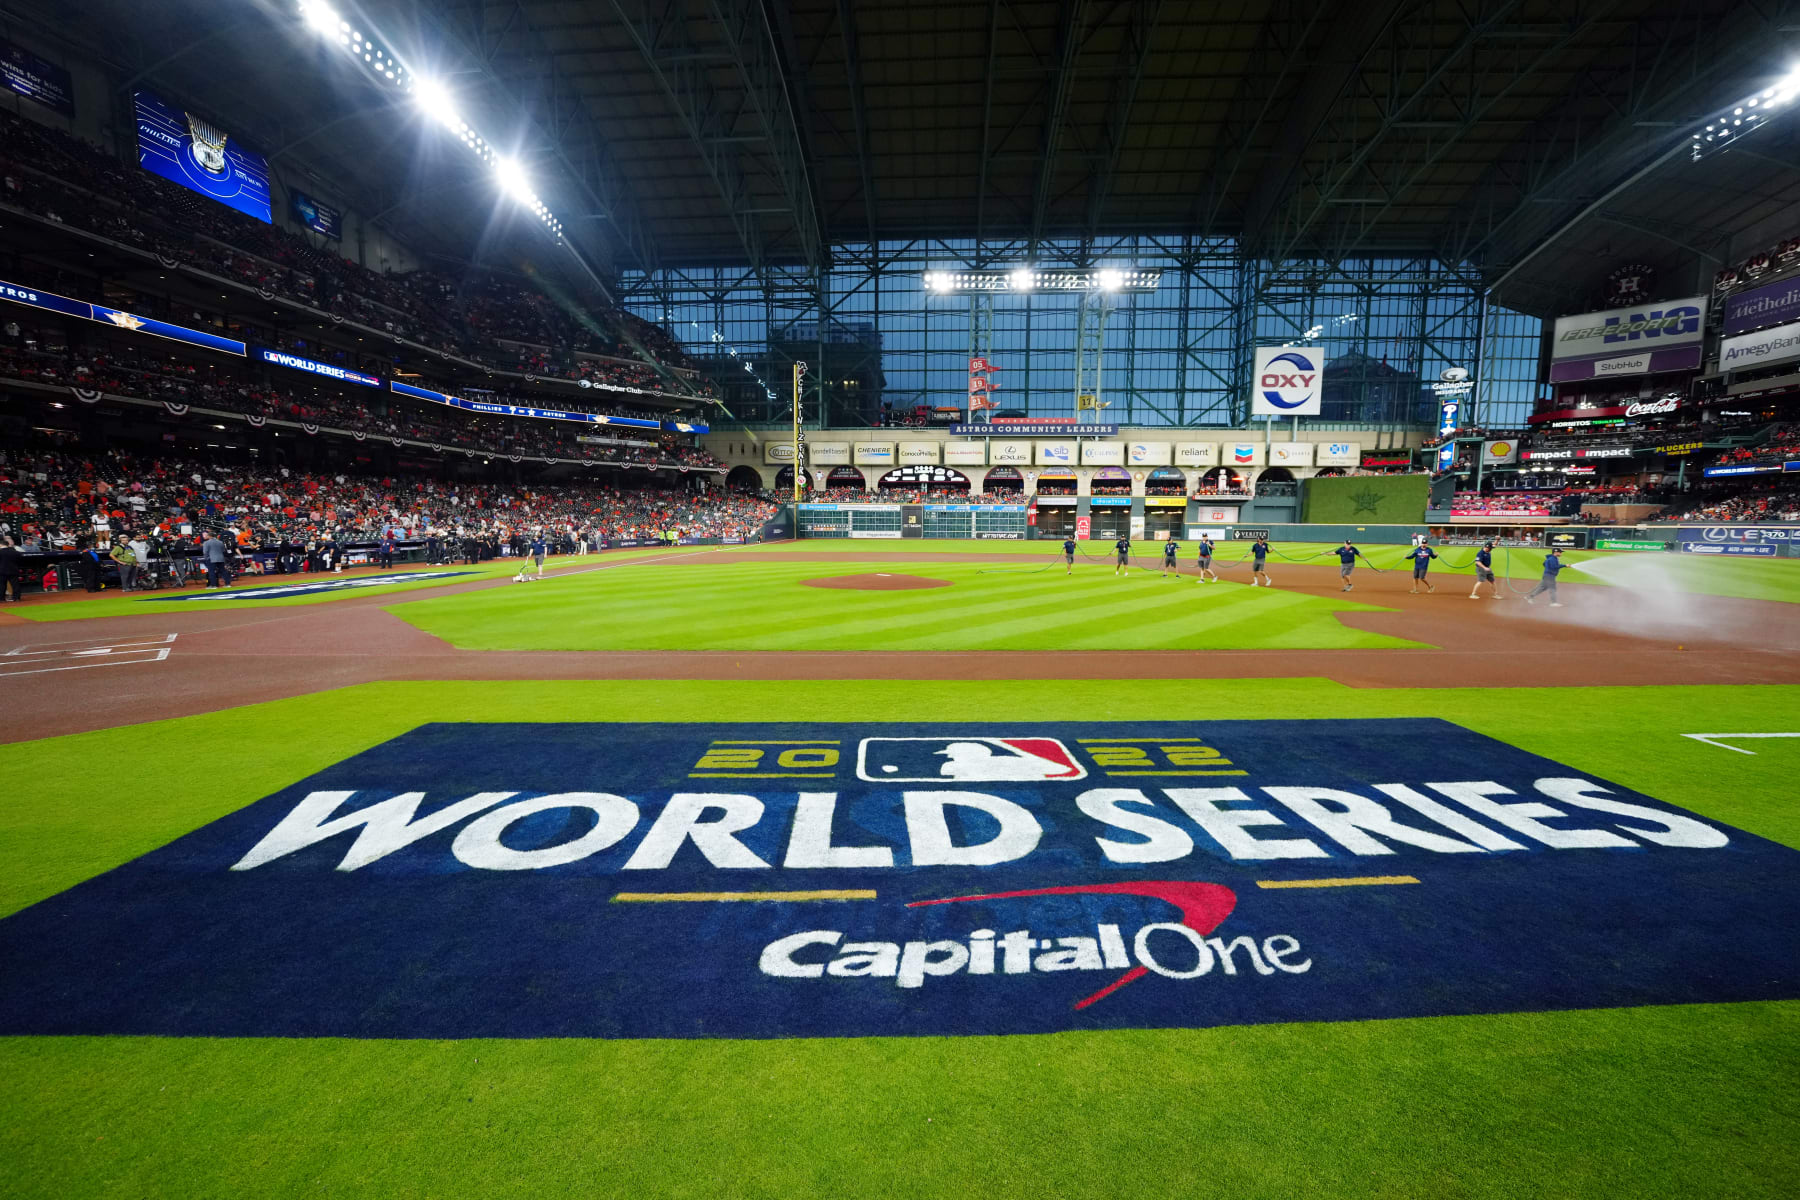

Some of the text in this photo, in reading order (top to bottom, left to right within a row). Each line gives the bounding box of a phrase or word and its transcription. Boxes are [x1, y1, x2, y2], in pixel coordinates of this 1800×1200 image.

[140, 125, 182, 148] PHILLIES
[1560, 315, 1682, 342] FREEPORT
[278, 353, 316, 371] WORLD
[316, 364, 345, 380] SERIES
[973, 360, 983, 369] 05
[1601, 360, 1643, 372] StubHub
[974, 380, 983, 388] 19
[1261, 374, 1316, 388] OXY
[1432, 381, 1475, 391] Gallagher
[593, 382, 643, 394] Gallagher Club
[472, 404, 503, 412] PHILLIES
[1081, 398, 1092, 407] 17
[1625, 396, 1682, 417] Coca-Cola
[542, 411, 566, 419] ASTROS
[1552, 420, 1591, 428] HORNITOS
[1181, 448, 1209, 456] reliant
[1585, 448, 1631, 458] impact
[1656, 442, 1703, 453] PLUCKERS
[1530, 450, 1572, 460] impact
[694, 748, 840, 770] 20
[1092, 746, 1233, 767] 22
[230, 777, 1730, 872] WORLD SERIES
